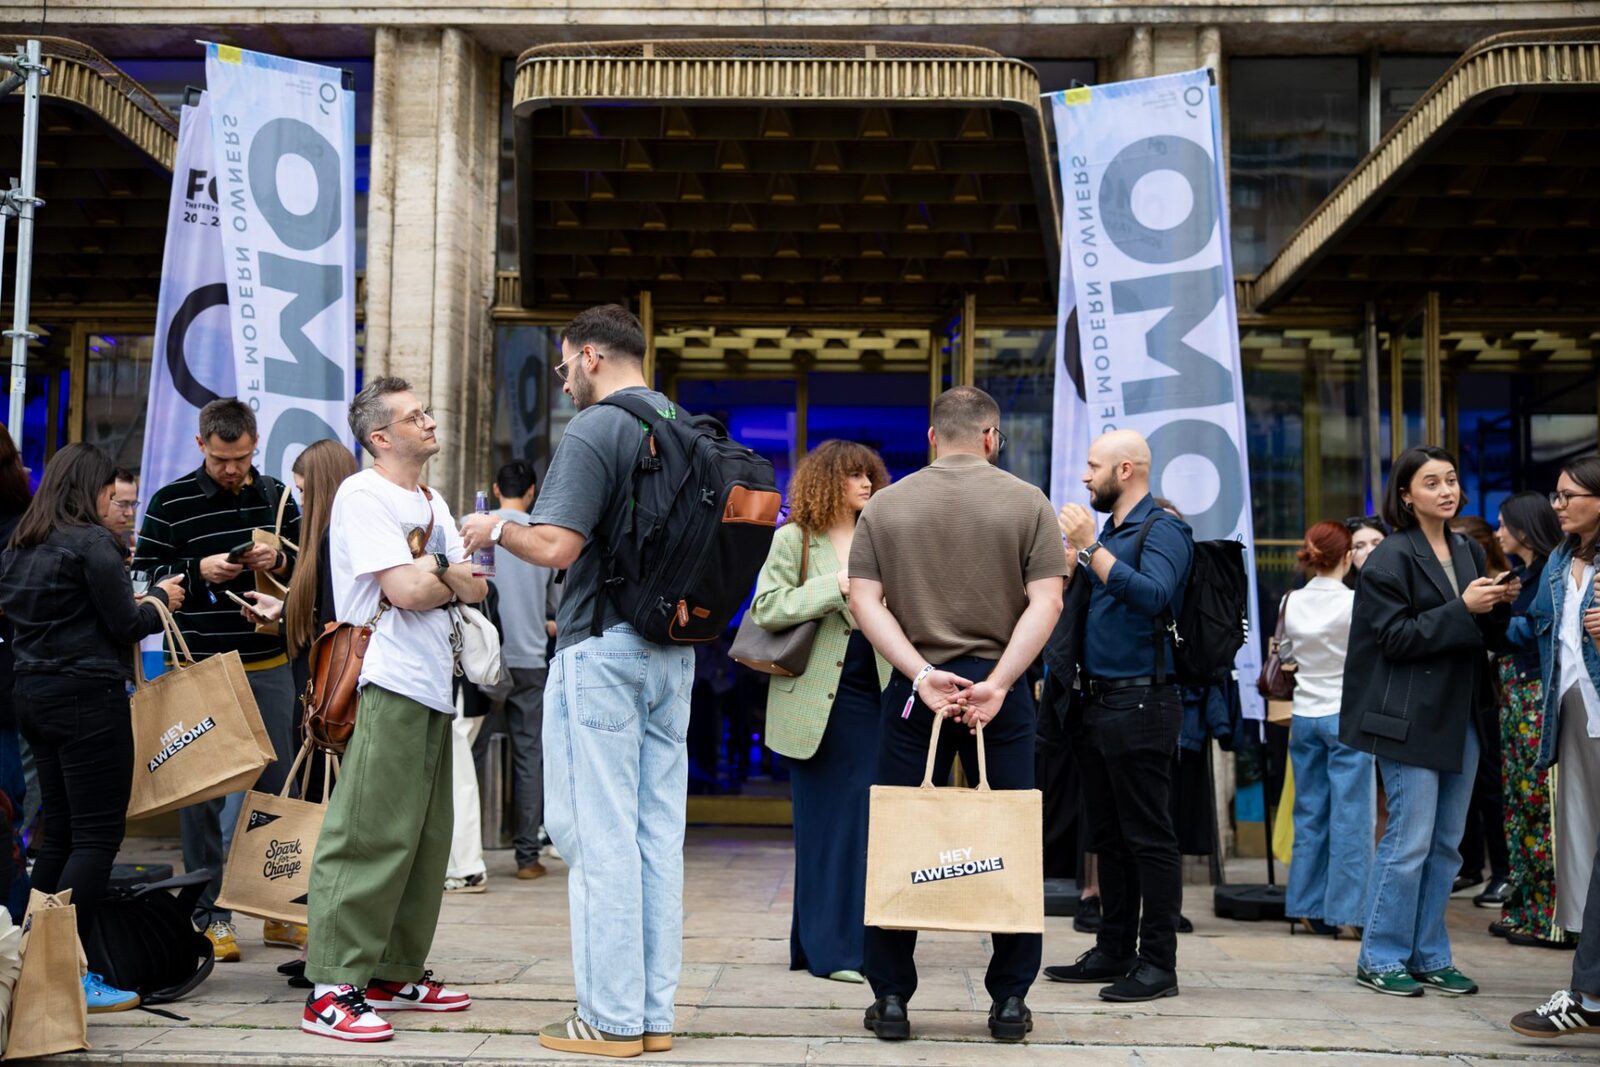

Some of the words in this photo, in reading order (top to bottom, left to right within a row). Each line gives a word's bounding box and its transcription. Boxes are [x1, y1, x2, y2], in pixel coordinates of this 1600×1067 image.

[184, 212, 197, 223] 20
[160, 721, 185, 745] HEY
[150, 717, 214, 771] AWESOME
[266, 838, 302, 860] Spark
[939, 847, 973, 864] HEY
[263, 861, 301, 879] Change
[276, 856, 289, 865] for
[913, 857, 1002, 883] AWESOME
